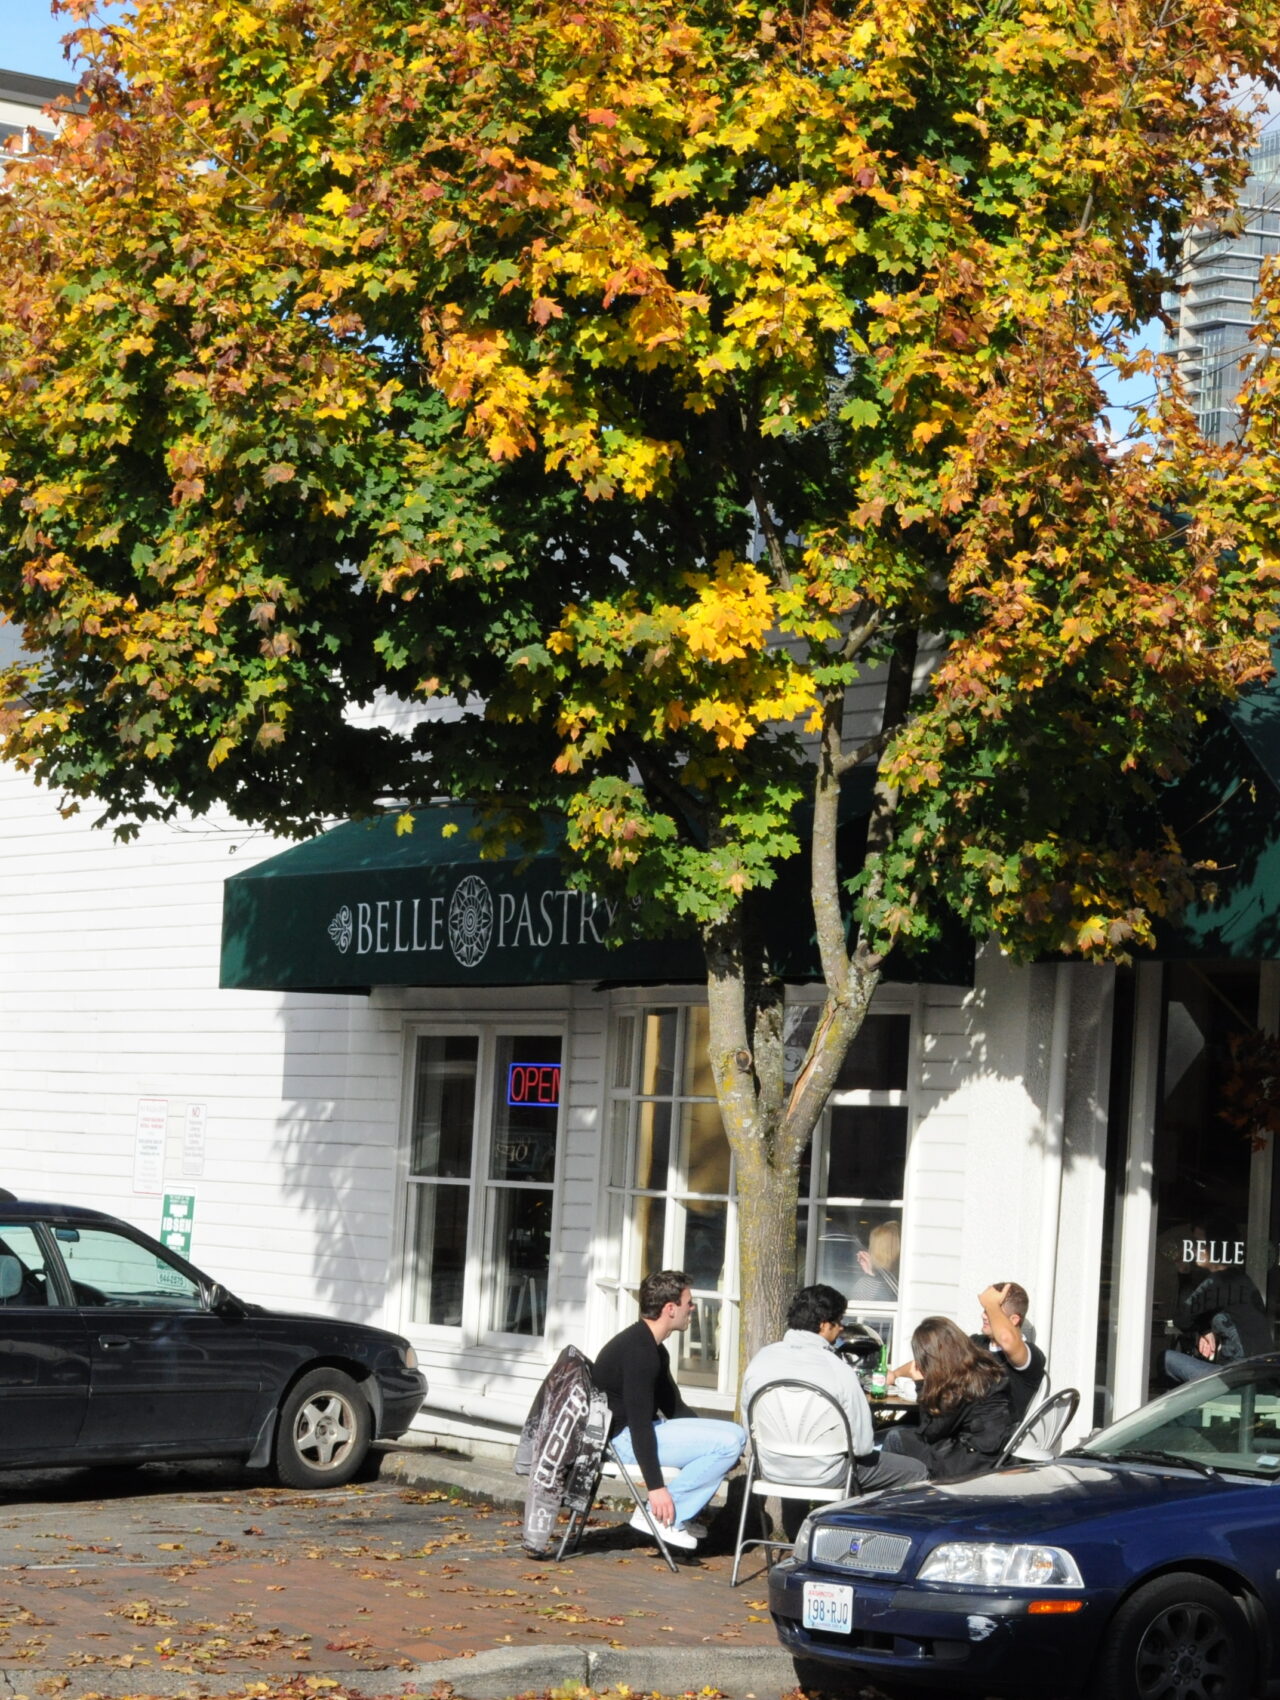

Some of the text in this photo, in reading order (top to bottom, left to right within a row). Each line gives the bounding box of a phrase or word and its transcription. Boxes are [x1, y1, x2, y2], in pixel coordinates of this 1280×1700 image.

[356, 897, 445, 954] BELLE
[511, 1067, 561, 1102] OPEN
[1182, 1239, 1244, 1265] BELLE
